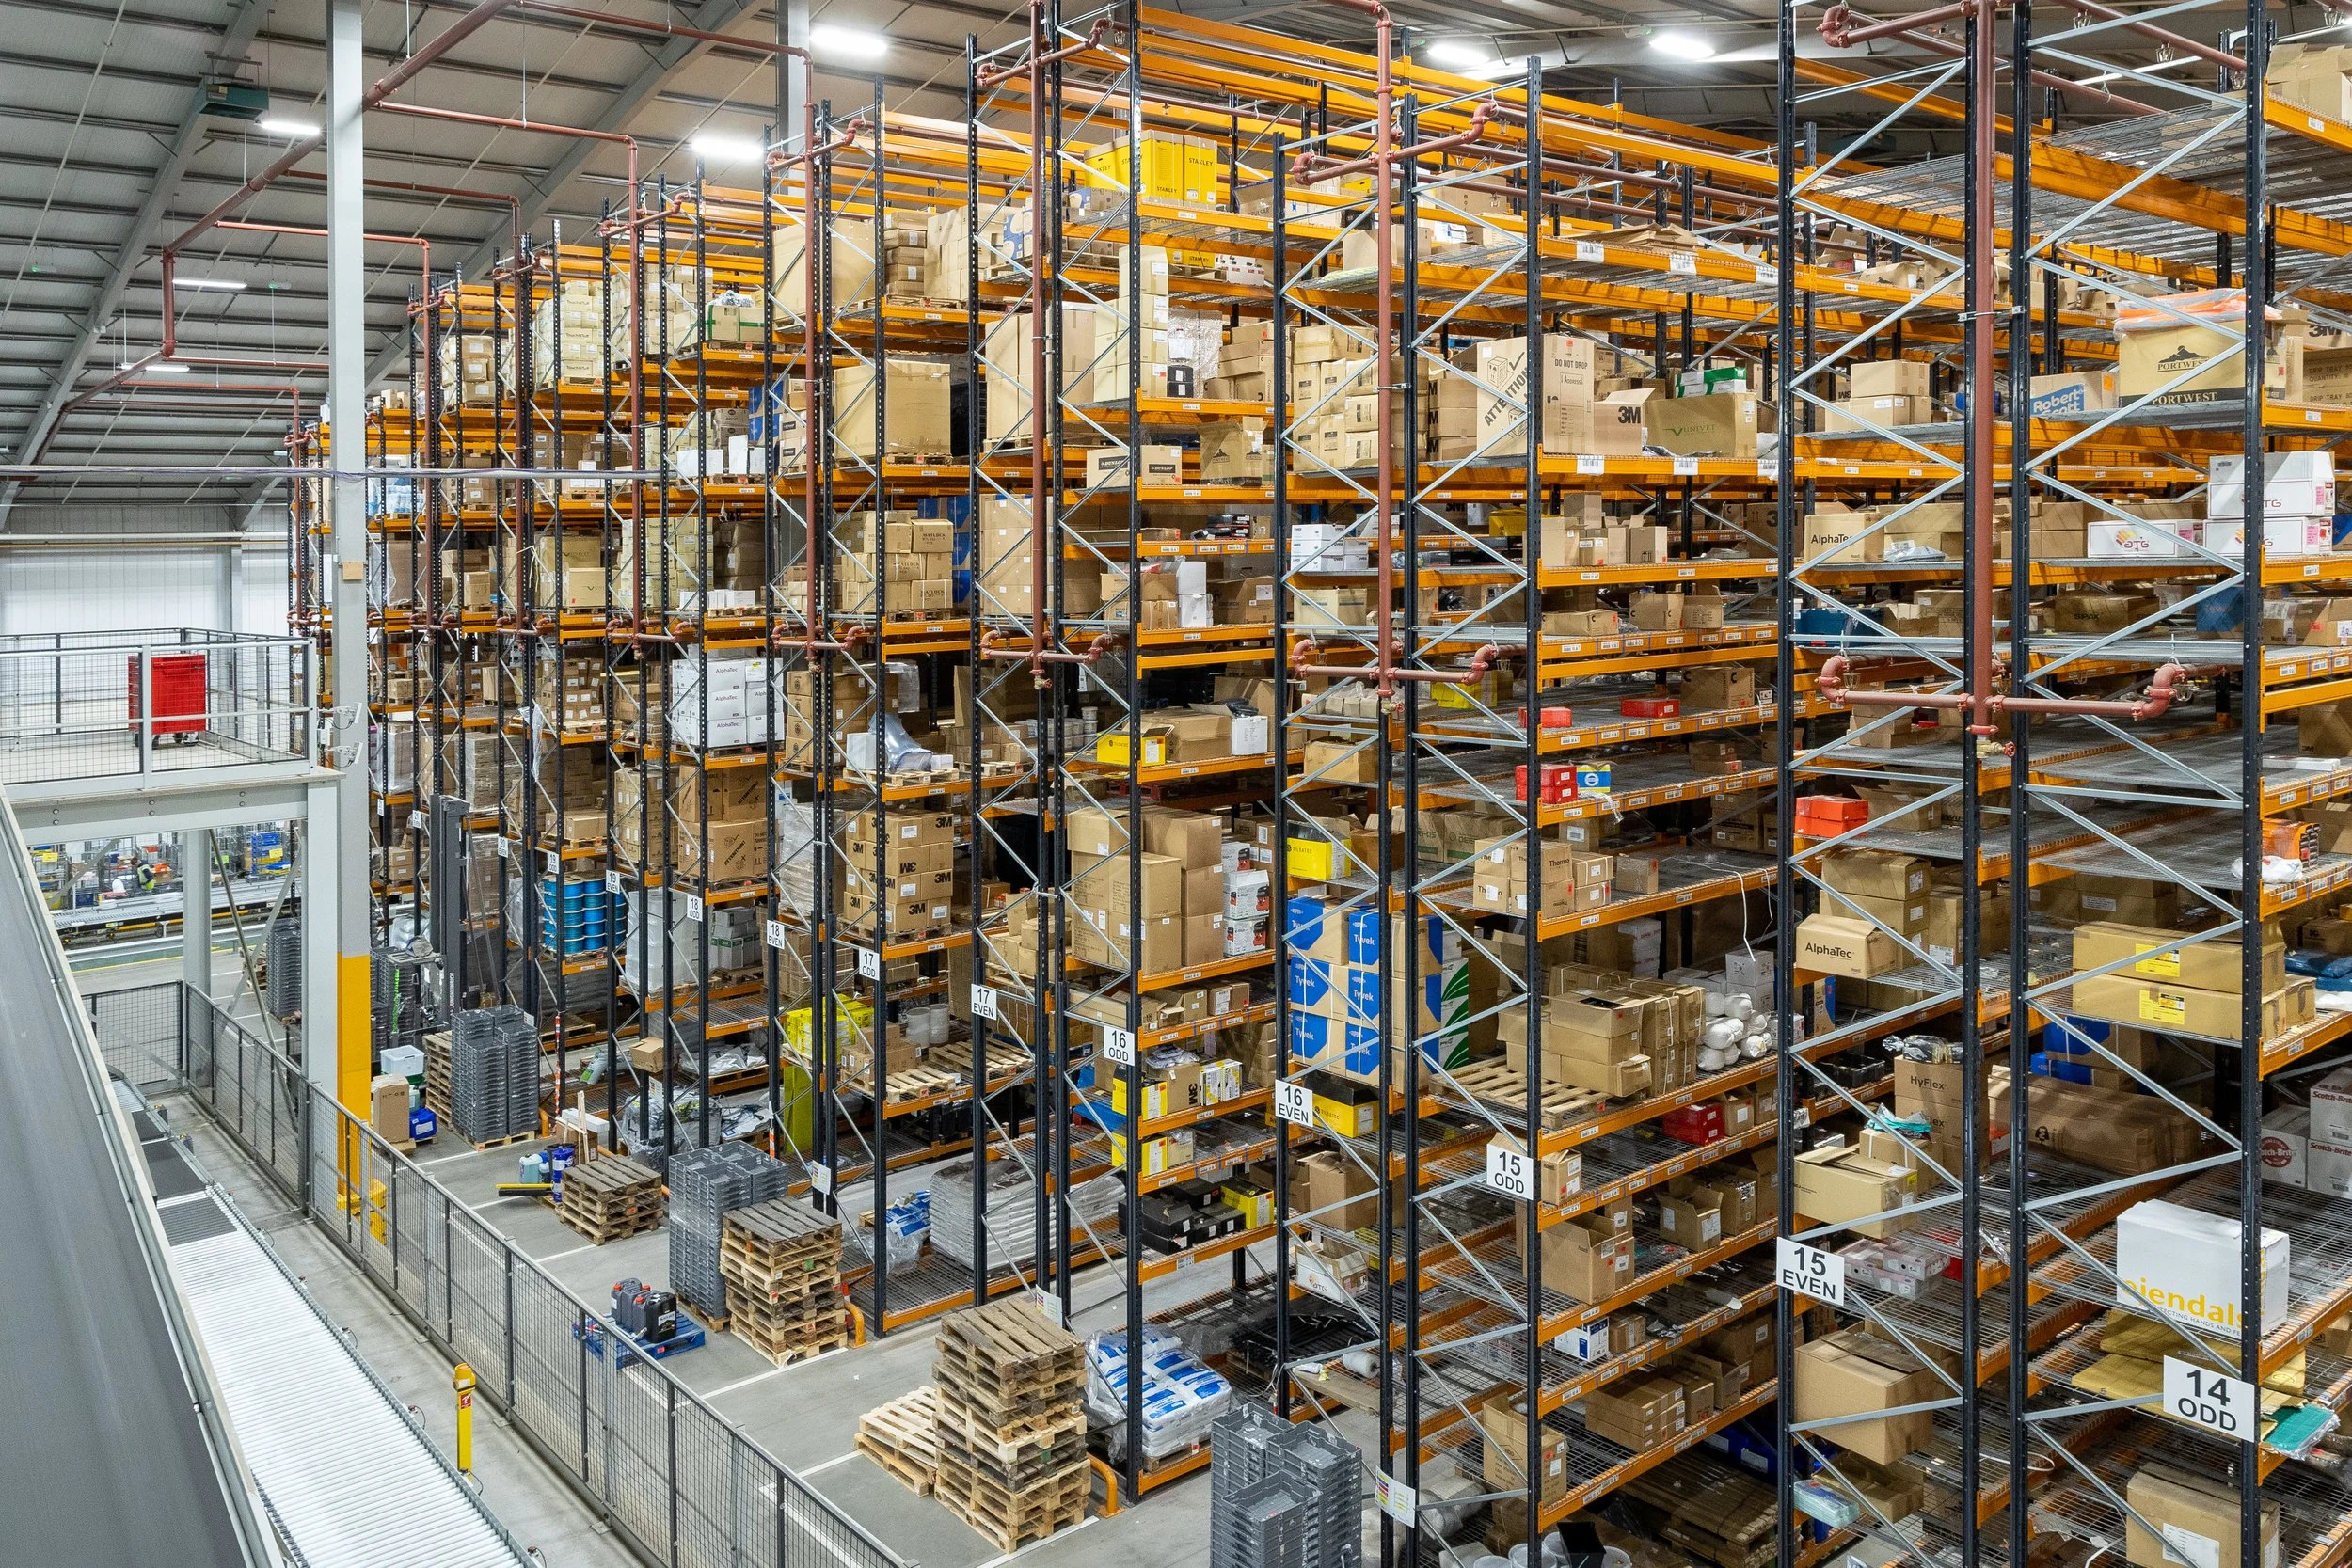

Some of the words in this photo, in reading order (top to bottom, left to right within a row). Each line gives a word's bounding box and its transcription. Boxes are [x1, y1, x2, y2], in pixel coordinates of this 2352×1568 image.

[1188, 157, 1214, 166] STANLEY
[1555, 359, 1564, 368] DO
[1565, 360, 1574, 369] NOT
[1574, 360, 1588, 370] DROP
[2157, 358, 2208, 371] PORTWES
[2033, 388, 2078, 412] Robert
[2152, 391, 2217, 405] PORTWEST
[1617, 406, 1642, 424] 3M
[1810, 532, 1851, 546] AlphaTe
[715, 694, 738, 703] AlphaTec
[935, 816, 953, 828] 3M
[852, 842, 864, 854] 3M
[549, 853, 557, 864] 19
[1549, 858, 1570, 867] Thermo
[899, 862, 917, 874] 3M
[609, 871, 617, 883] 19
[884, 877, 896, 889] 3M
[934, 871, 951, 883] 3M
[607, 882, 619, 892] EVEN
[691, 897, 699, 910] 18
[850, 896, 861, 909] 3M
[908, 902, 926, 915] 3M
[689, 909, 700, 920] ODD
[771, 924, 780, 938] 18
[768, 935, 783, 948] EVEN
[1354, 933, 1375, 946] Tyvek
[1804, 941, 1852, 959] AlphaTec
[864, 951, 874, 967] 17
[862, 966, 876, 977] ODD
[1295, 975, 1315, 988] Tyvek
[977, 988, 990, 1005] 17
[1353, 989, 1374, 1002] Tyvek
[973, 1003, 994, 1018] EVEN
[1111, 1030, 1127, 1049] 16
[1295, 1027, 1314, 1040] Tyvek
[1108, 1047, 1129, 1062] ODD
[1909, 1075, 1946, 1091] HyFlex
[1188, 1083, 1198, 1105] 3M
[1284, 1085, 1303, 1107] 16
[1279, 1104, 1310, 1124] EVEN
[1499, 1151, 1521, 1176] 15
[1494, 1172, 1525, 1194] ODD
[1793, 1246, 1827, 1277] 15
[1783, 1269, 1836, 1300] EVEN
[2190, 1316, 2215, 1328] HANDS
[2215, 1323, 2232, 1334] AND
[2186, 1370, 2231, 1407] 14
[2178, 1397, 2237, 1432] ODD
